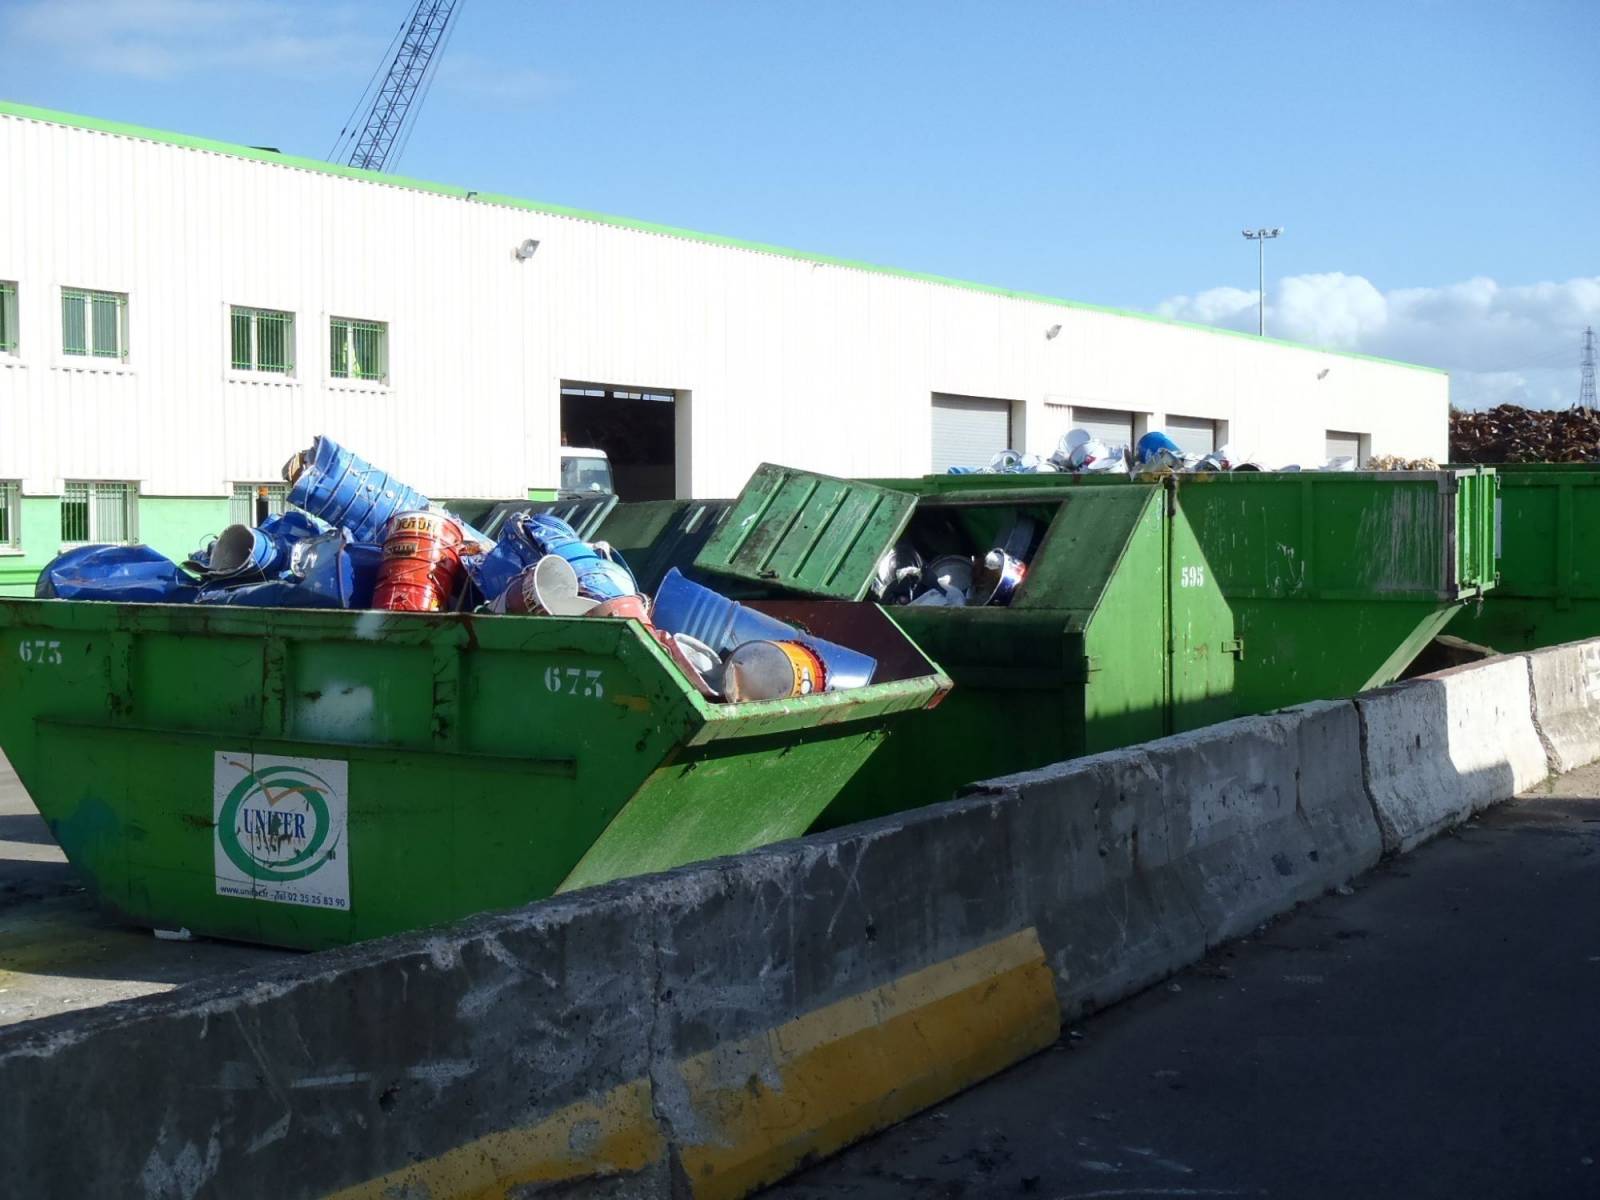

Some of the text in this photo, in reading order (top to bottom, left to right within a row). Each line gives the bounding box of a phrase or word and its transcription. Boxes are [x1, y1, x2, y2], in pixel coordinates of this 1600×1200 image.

[1181, 566, 1204, 588] 595
[19, 640, 62, 664] 673
[544, 667, 603, 697] 673
[243, 808, 306, 839] UNIFER
[287, 892, 297, 902] 02
[299, 893, 309, 903] 35
[311, 895, 321, 905] 25
[323, 896, 334, 906] 83
[335, 897, 346, 907] 90
